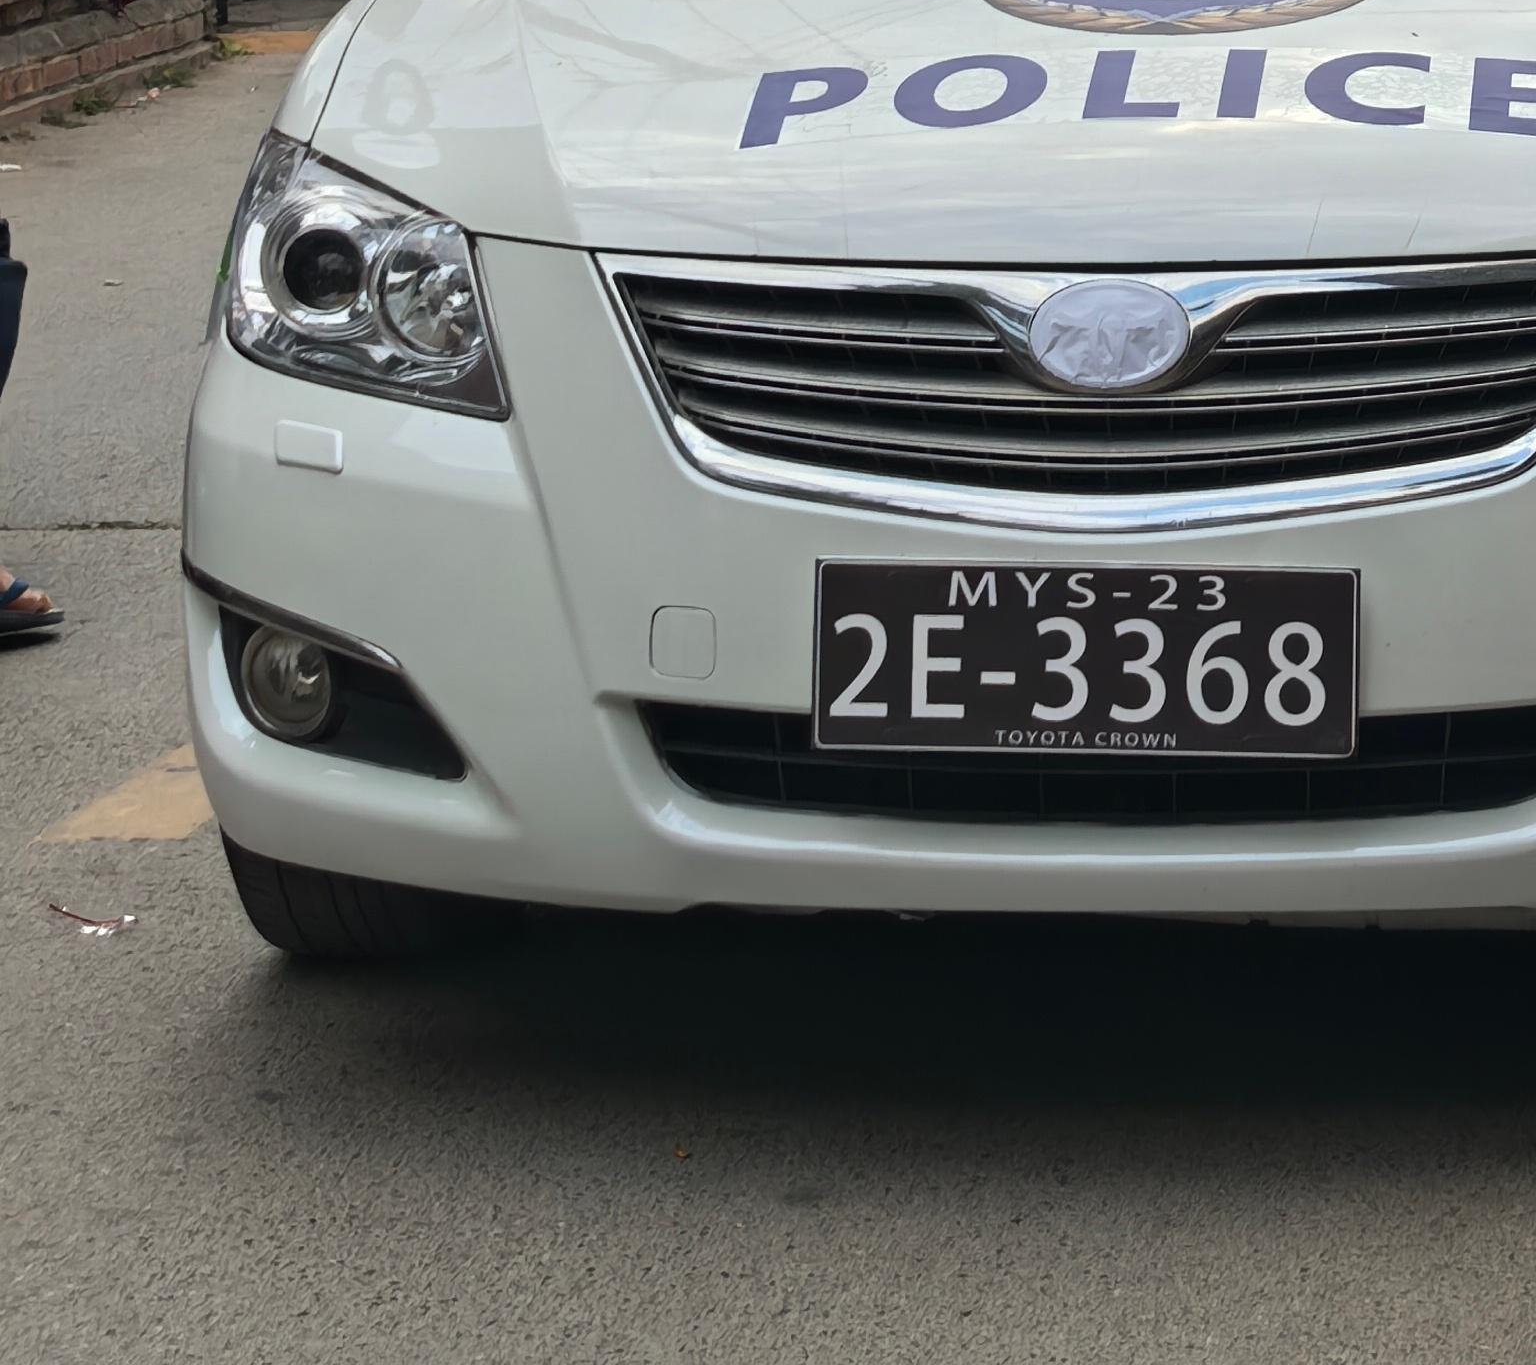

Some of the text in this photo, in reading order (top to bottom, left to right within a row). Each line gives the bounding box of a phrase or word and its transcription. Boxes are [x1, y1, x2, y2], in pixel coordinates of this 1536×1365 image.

[947, 571, 1228, 611] MYS-23
[828, 613, 1327, 727] 2E-3368
[994, 729, 1177, 749] TOYOTA CROWN
